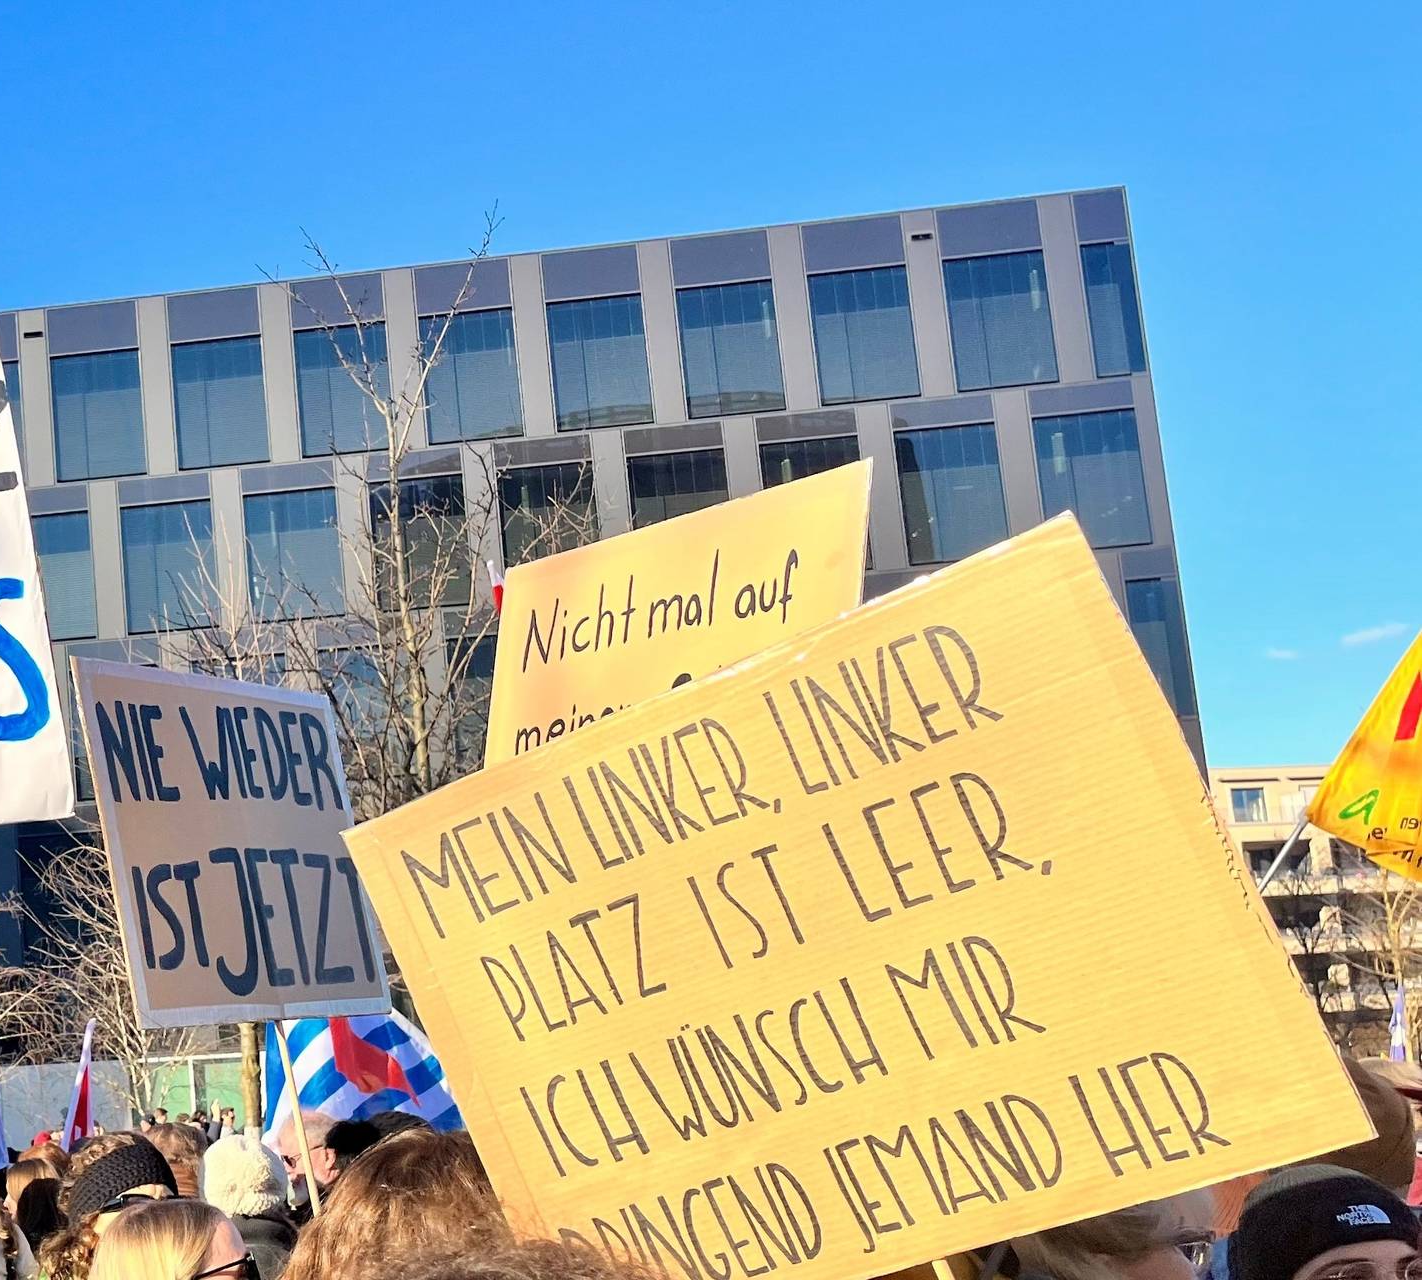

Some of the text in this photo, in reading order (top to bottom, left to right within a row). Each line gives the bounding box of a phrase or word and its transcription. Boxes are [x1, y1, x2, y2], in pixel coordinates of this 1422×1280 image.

[522, 549, 799, 673] Nicht mal auf
[95, 701, 343, 811] NIE WIEDER
[400, 625, 1005, 940] MEIN LINKER, LINKER
[131, 847, 376, 996] IST JETZT
[480, 893, 668, 1041] PLATZ
[686, 843, 806, 969] IST
[520, 936, 1046, 1177] ICH WÜNSCH MIR
[823, 1093, 1063, 1254] JEMAND
[1070, 1052, 1231, 1178] HER
